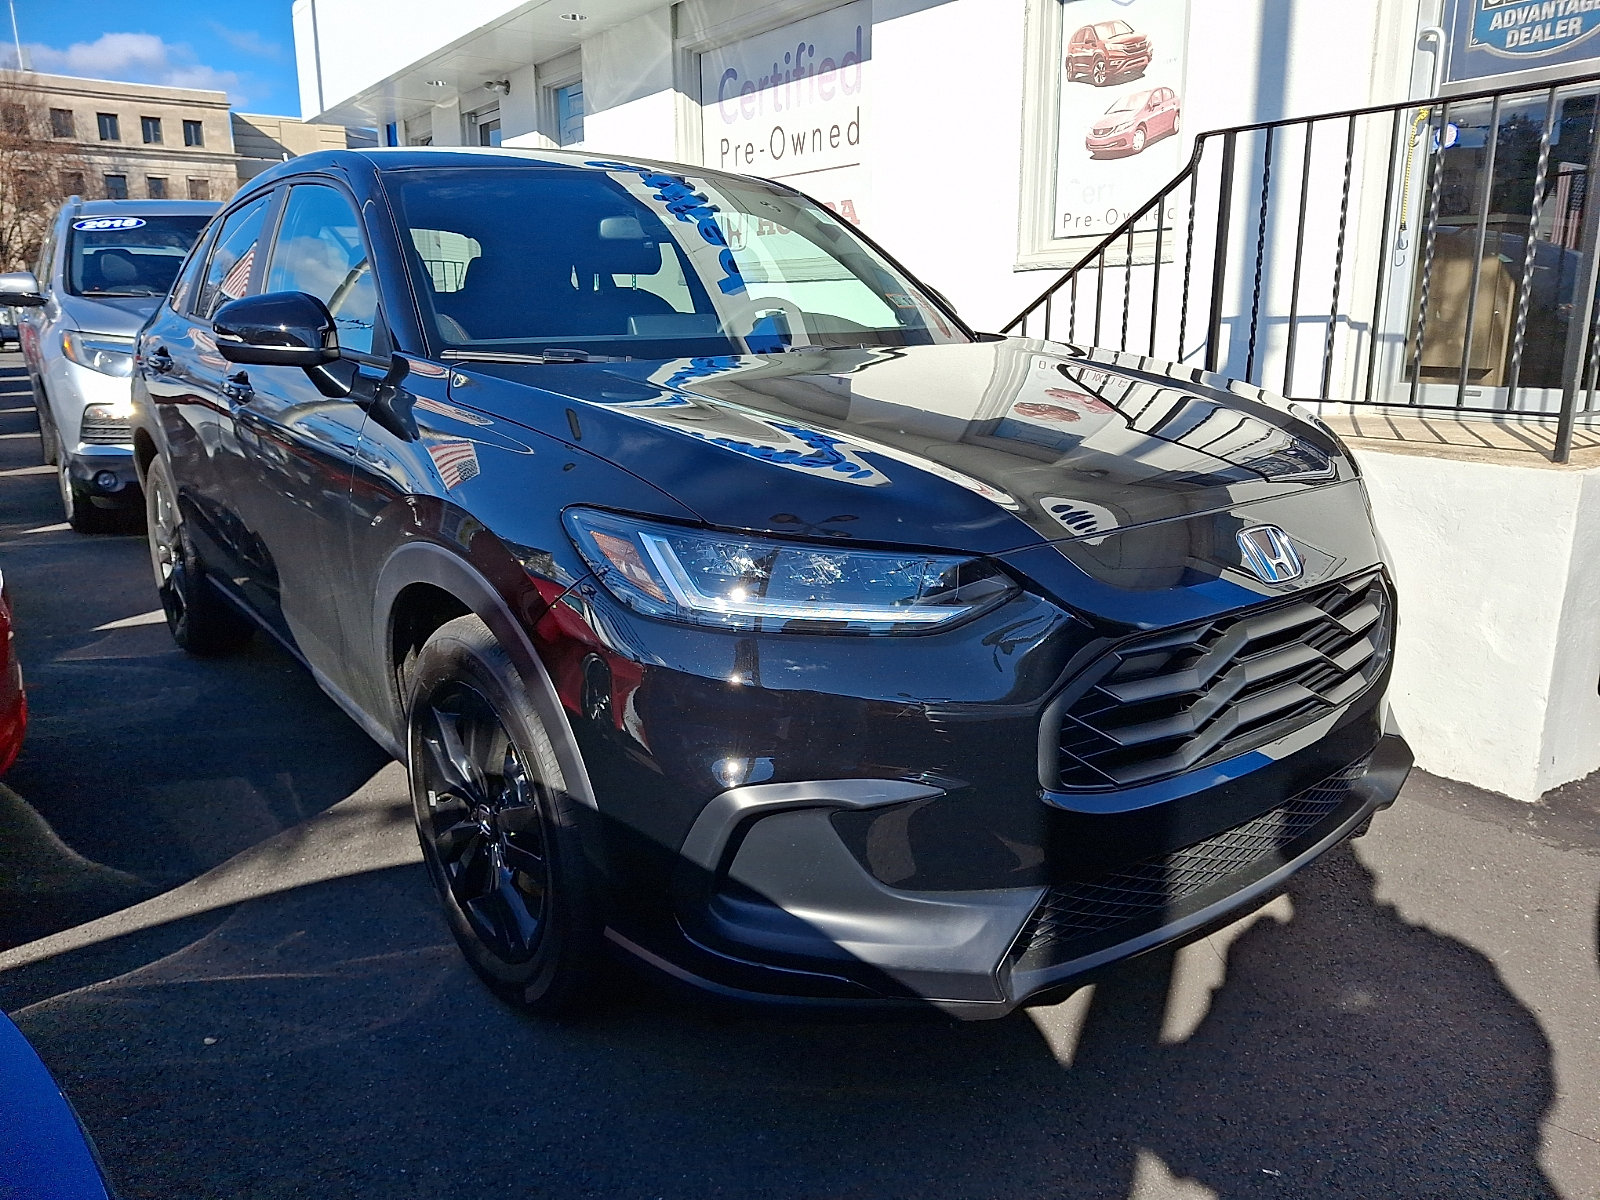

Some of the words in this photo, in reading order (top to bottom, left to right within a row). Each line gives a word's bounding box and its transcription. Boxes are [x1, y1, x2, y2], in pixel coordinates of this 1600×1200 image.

[1505, 16, 1583, 48] DEALER
[718, 25, 862, 124] Certified
[720, 106, 860, 168] Pre-Owned
